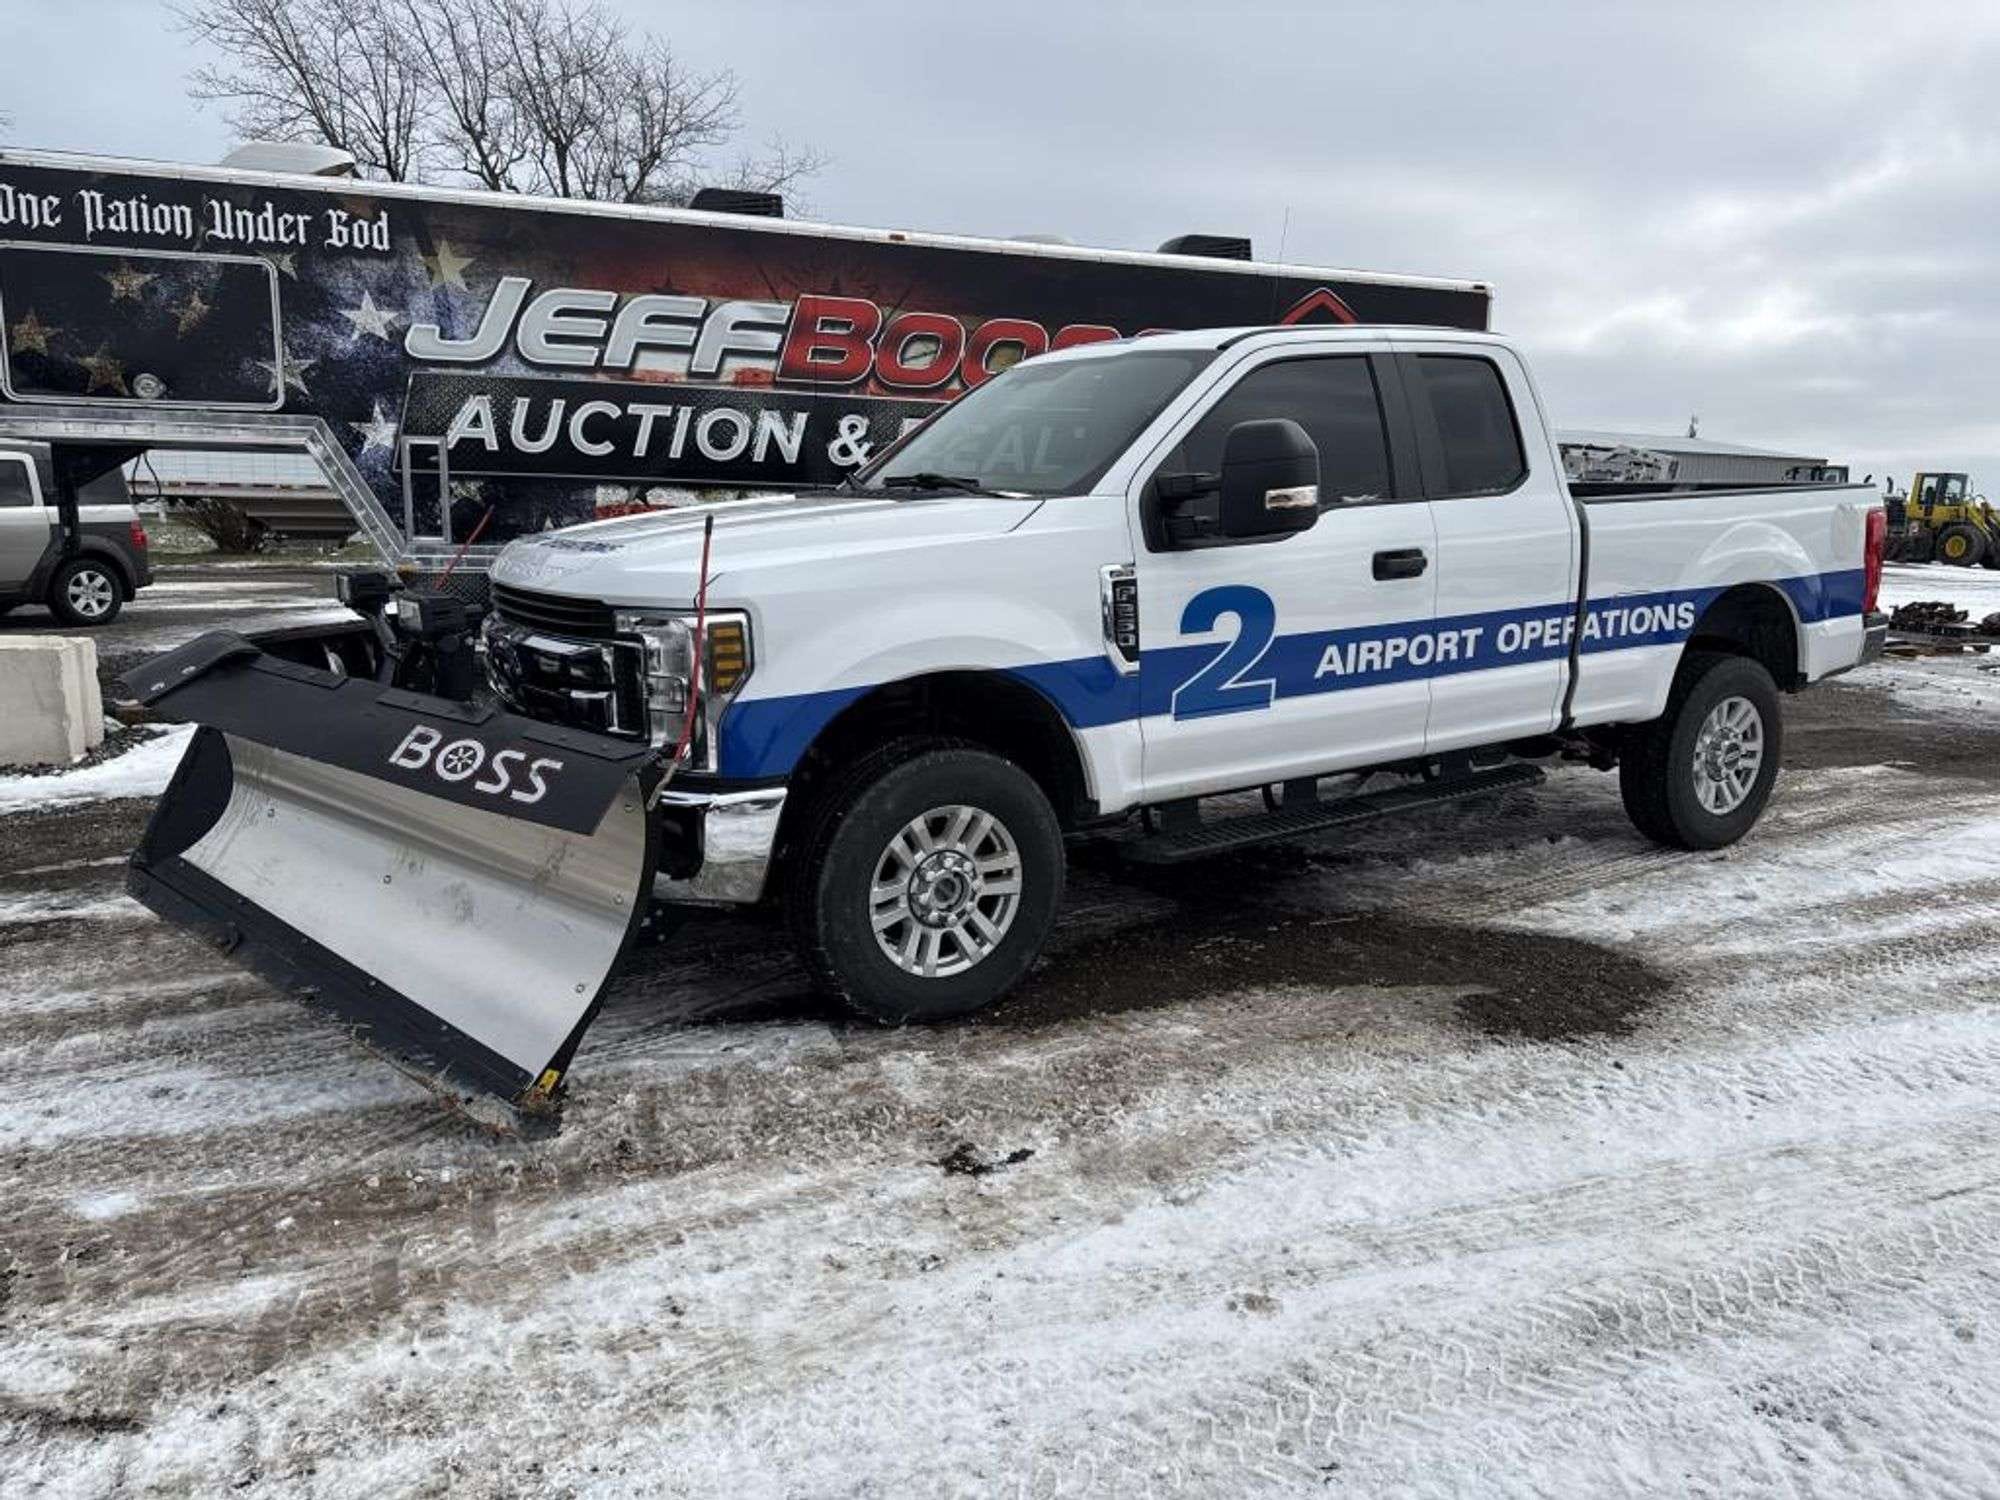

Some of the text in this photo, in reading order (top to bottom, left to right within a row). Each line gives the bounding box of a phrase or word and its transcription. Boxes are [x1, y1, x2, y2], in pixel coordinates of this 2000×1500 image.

[77, 189, 193, 241] Nation
[204, 199, 312, 245] Under
[324, 209, 391, 251] God
[446, 395, 807, 464] AUCTION
[828, 414, 873, 466] &
[1173, 584, 1276, 722] 2
[1314, 602, 1695, 679] AIRPORT OPERATIONS
[389, 725, 564, 803] BOSS
